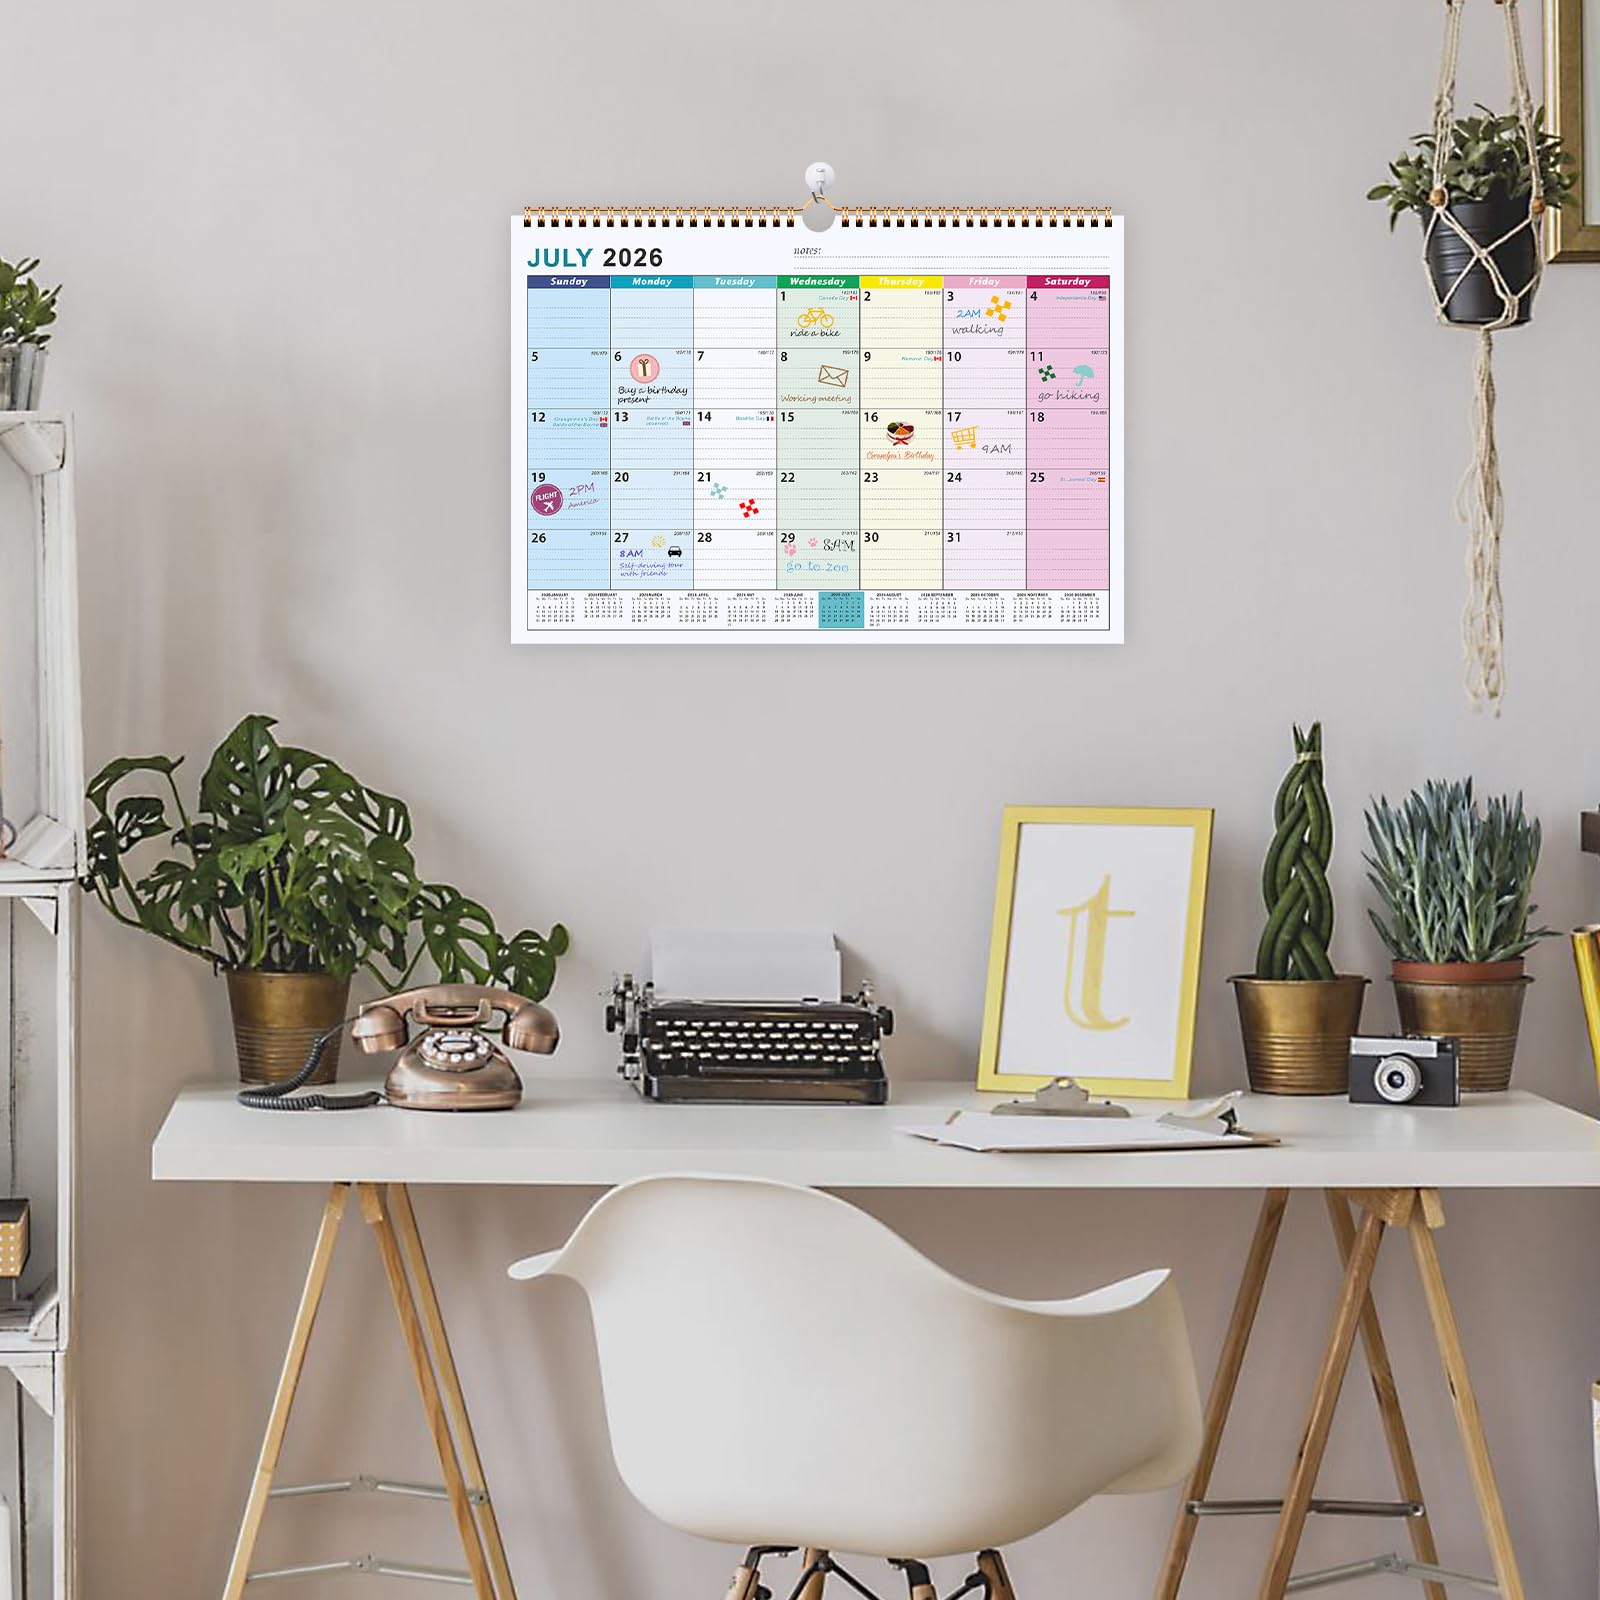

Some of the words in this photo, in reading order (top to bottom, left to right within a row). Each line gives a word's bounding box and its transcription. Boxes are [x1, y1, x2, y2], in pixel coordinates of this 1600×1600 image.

[527, 248, 593, 267] JULY
[603, 248, 663, 267] 2026
[551, 277, 588, 286] Sunday
[632, 277, 672, 286] Monday
[715, 277, 755, 286] Tuesday
[790, 278, 846, 287] Wednesday
[878, 278, 924, 287] Thursday
[969, 278, 1000, 287] Friday
[1045, 278, 1091, 287] Saturday
[781, 291, 785, 301] 1
[864, 292, 871, 301] 2
[947, 291, 954, 301] 3
[1030, 291, 1037, 301] 4
[956, 309, 981, 318] 2AM
[790, 329, 809, 337] ride
[821, 329, 840, 337] bike
[952, 324, 1004, 336] walking
[532, 352, 538, 361] 5
[615, 352, 621, 361] 6
[697, 351, 704, 361] 7
[781, 352, 787, 361] 8
[864, 352, 871, 361] 9
[947, 352, 961, 361] 10
[1030, 352, 1043, 361] 11
[618, 386, 636, 395] Buy
[647, 386, 688, 396] birthday
[1038, 393, 1053, 402] go
[1056, 390, 1100, 402] hiking
[617, 396, 650, 404] present
[781, 395, 817, 404] Working
[819, 394, 851, 403] meeting
[532, 412, 545, 422] 12
[615, 412, 628, 422] 13
[697, 412, 711, 421] 14
[781, 412, 794, 422] 15
[864, 412, 878, 422] 16
[947, 412, 961, 422] 17
[1030, 412, 1044, 422] 18
[981, 444, 1011, 454] 9AM
[866, 451, 901, 462] Grandpa's
[904, 451, 935, 462] Birthday
[532, 473, 545, 482] 19
[615, 472, 629, 482] 20
[697, 472, 711, 482] 21
[781, 473, 795, 482] 22
[864, 473, 878, 482] 23
[947, 473, 962, 482] 24
[1030, 473, 1044, 482] 25
[570, 482, 595, 496] 2PM
[535, 491, 558, 501] FLIGHT
[568, 498, 600, 509] America
[532, 533, 546, 543] 26
[615, 533, 629, 543] 27
[697, 533, 712, 543] 28
[781, 533, 795, 543] 29
[864, 532, 879, 542] 30
[947, 532, 960, 542] 31
[823, 538, 855, 552] 8AM
[620, 549, 643, 558] 8AM
[786, 560, 802, 573] go
[808, 561, 821, 571] to
[826, 562, 849, 572] zoo
[640, 570, 668, 578] friends
[1057, 873, 1136, 1031] t
